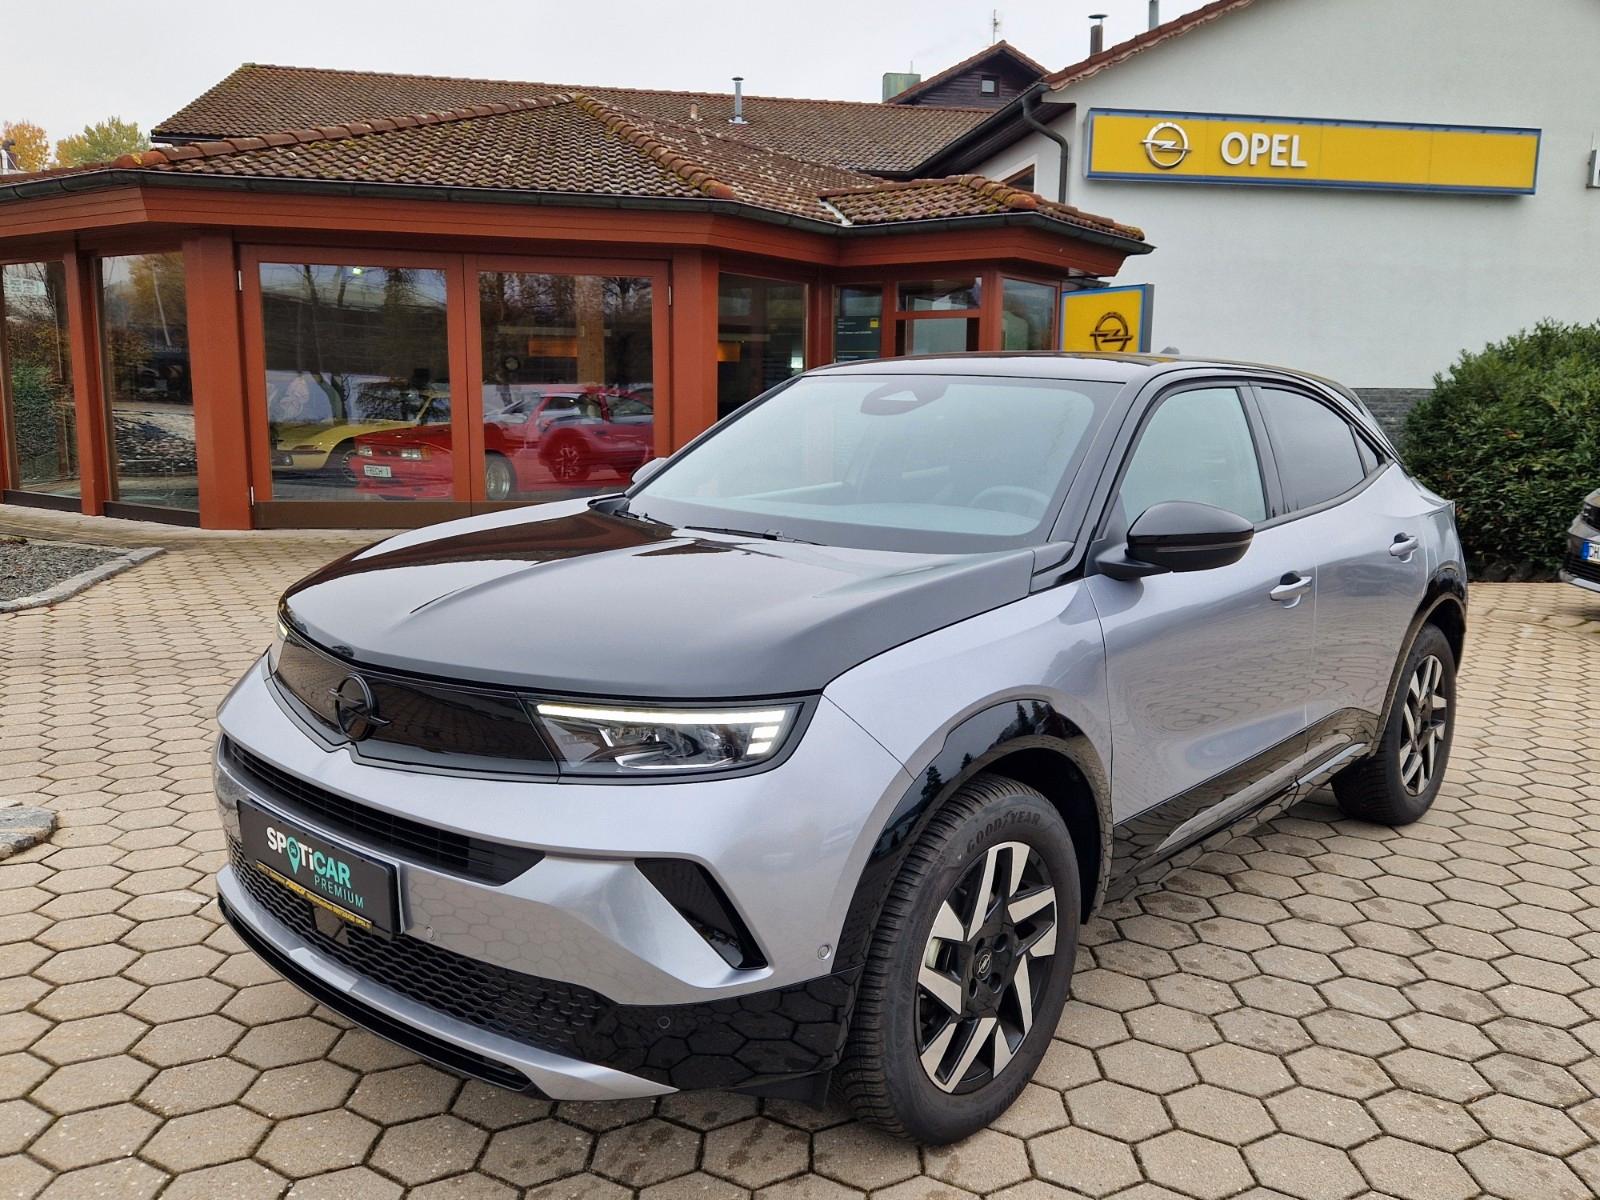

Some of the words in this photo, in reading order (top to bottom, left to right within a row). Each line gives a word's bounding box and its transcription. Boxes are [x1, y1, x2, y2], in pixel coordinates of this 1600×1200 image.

[1221, 131, 1308, 167] OPEL
[967, 810, 1040, 853] GOODYEAR
[314, 875, 364, 909] PREMIUM
